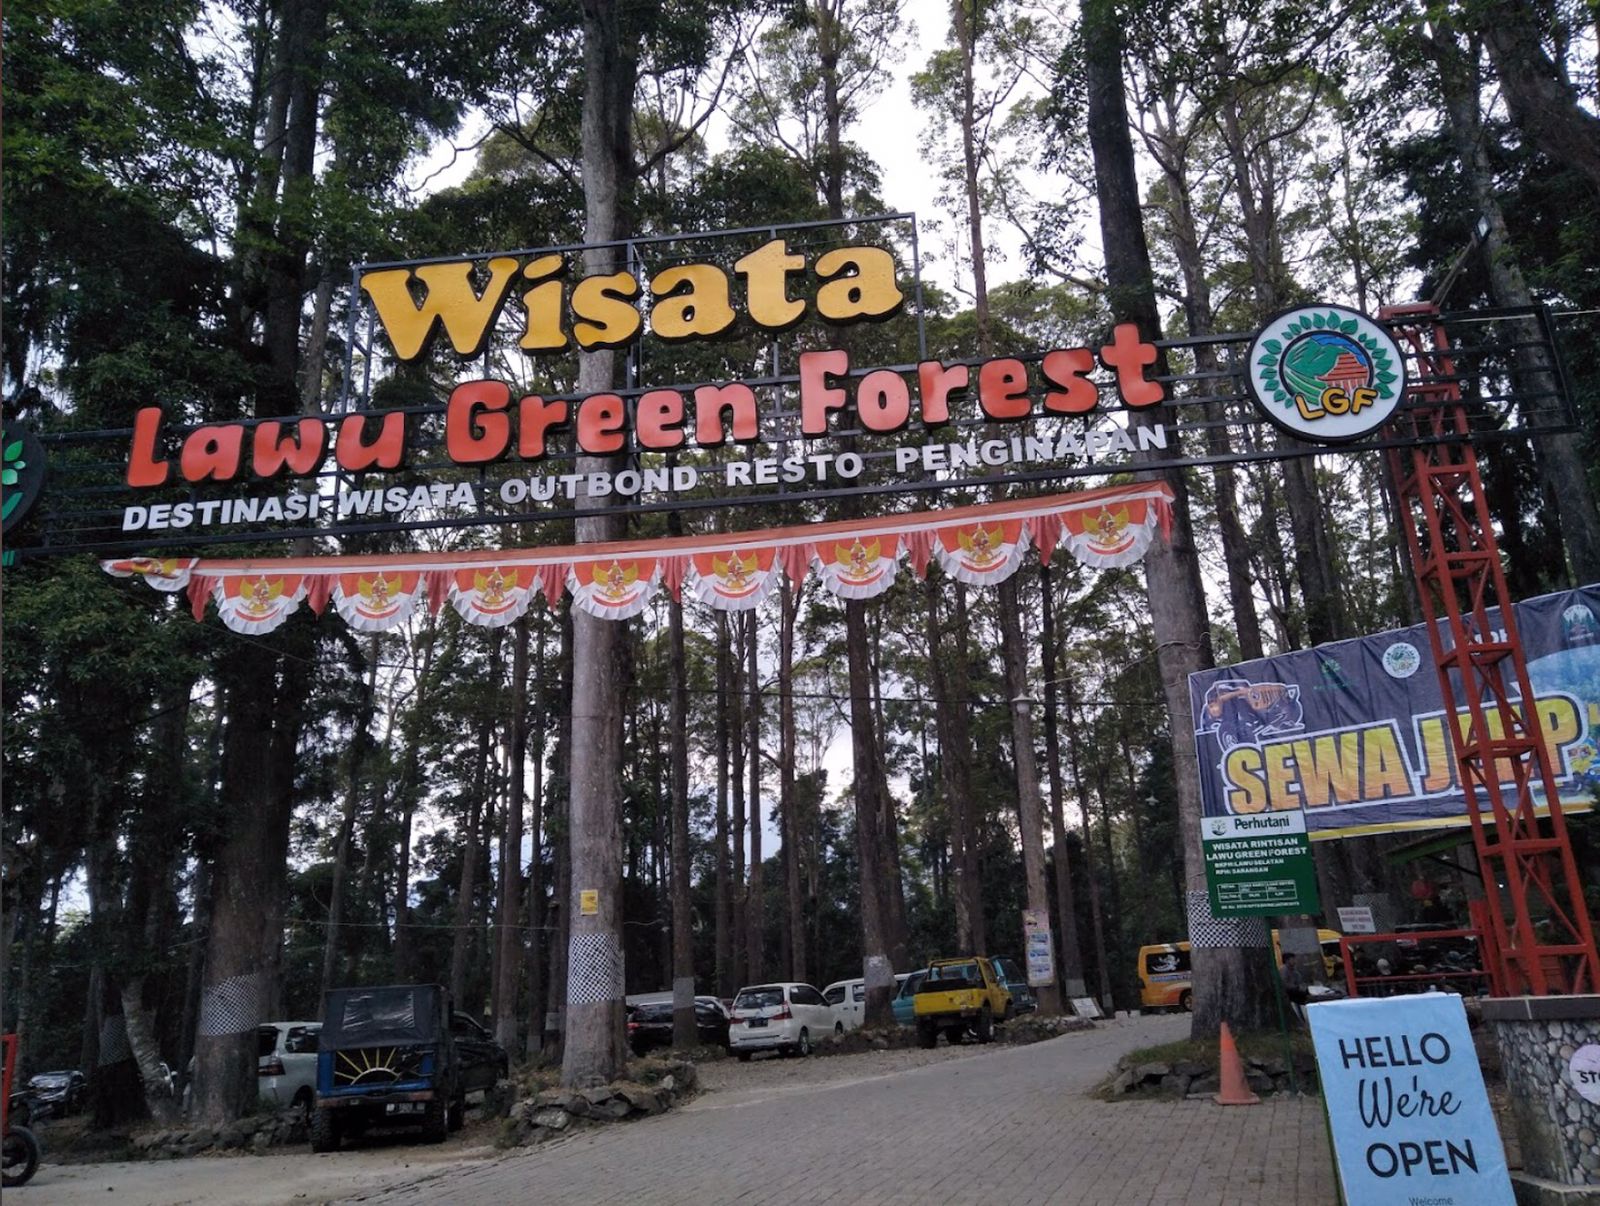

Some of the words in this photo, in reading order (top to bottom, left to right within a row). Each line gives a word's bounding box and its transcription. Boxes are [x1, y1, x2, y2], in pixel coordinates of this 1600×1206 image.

[360, 239, 903, 361] Wisata
[127, 407, 405, 488] Lawu
[446, 379, 758, 465] Green
[799, 323, 1164, 436] Forest
[1295, 387, 1378, 420] LGF
[122, 493, 319, 532] DESTINASI
[338, 482, 477, 516] WISATA
[500, 466, 698, 505] OUTBOND
[726, 452, 863, 487] RESTO
[896, 424, 1167, 473] PENGINAPAN
[1227, 726, 1411, 815] SEWA
[1233, 814, 1290, 830] Perhutani
[1206, 851, 1234, 861] LAWU
[1234, 849, 1268, 859] GREEN
[1268, 847, 1307, 857] FOREST
[1212, 841, 1249, 851] WISATA
[1250, 838, 1298, 848] RINTISAN
[1338, 1032, 1451, 1069] HELLO
[1580, 1070, 1600, 1084] ST
[1358, 1075, 1462, 1129] We're
[1366, 1139, 1479, 1178] OPEN
